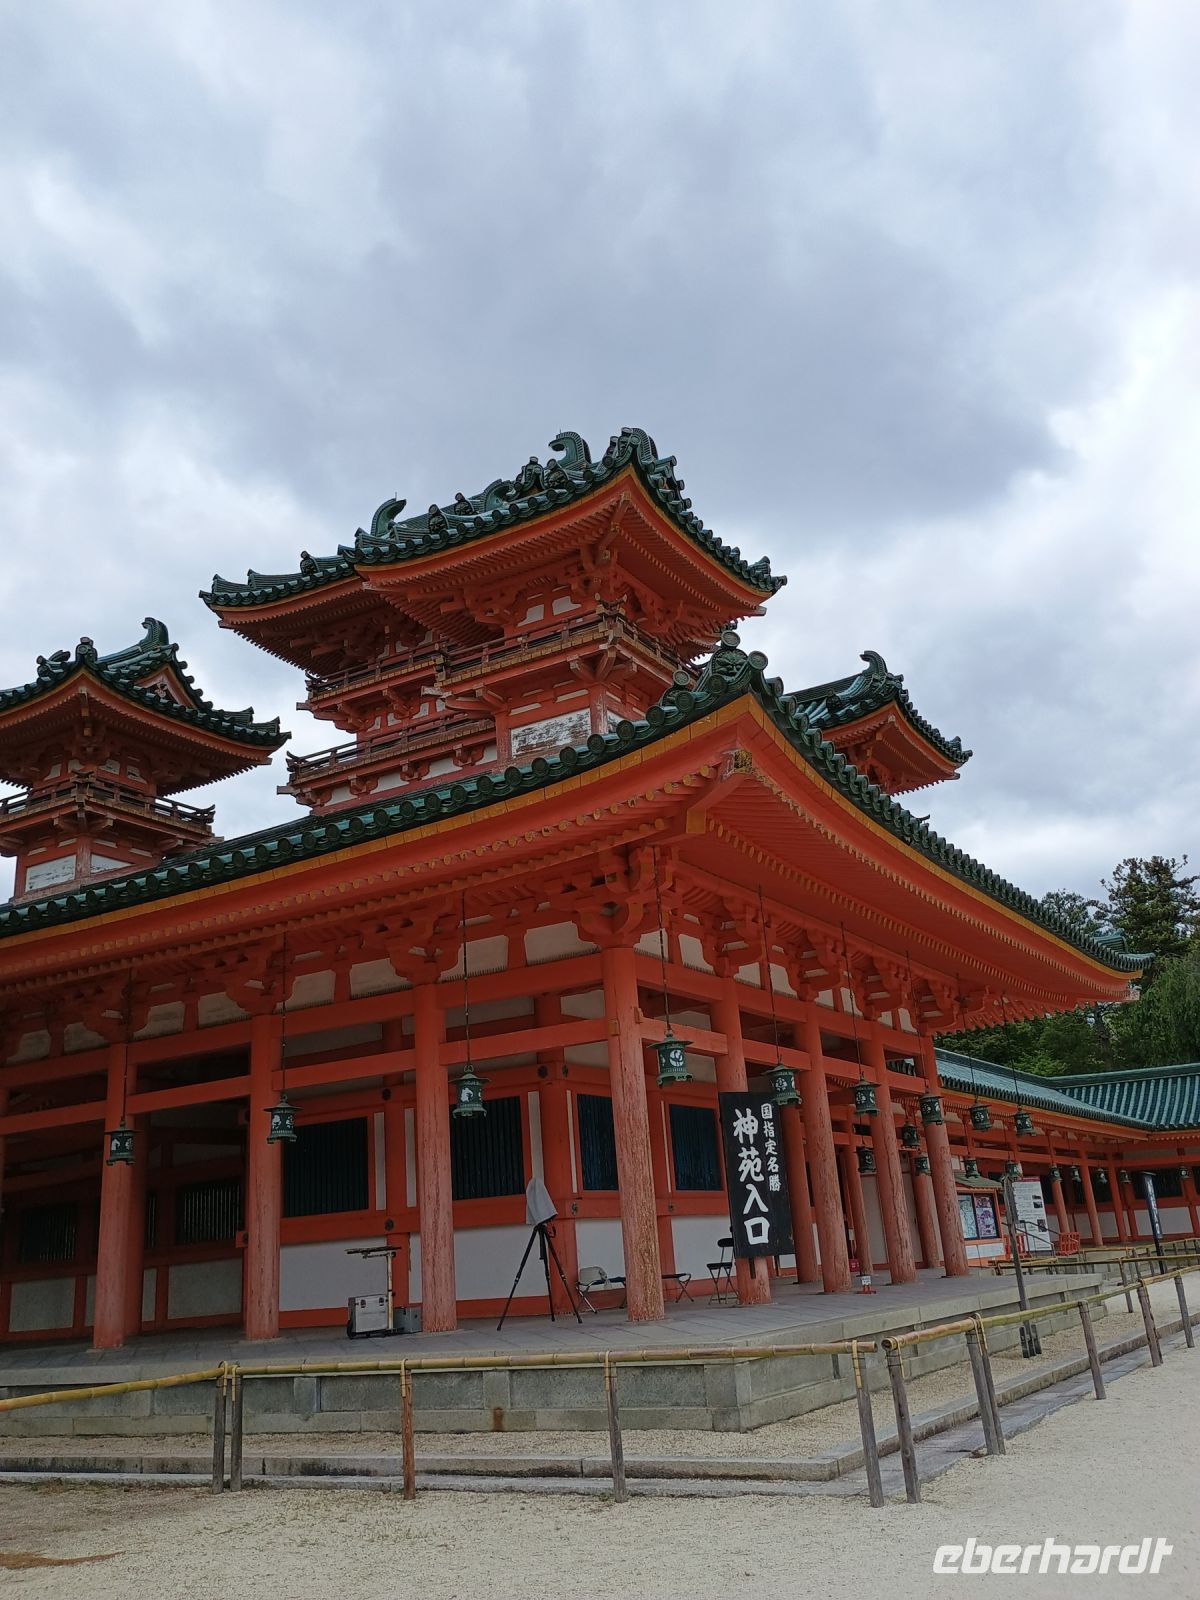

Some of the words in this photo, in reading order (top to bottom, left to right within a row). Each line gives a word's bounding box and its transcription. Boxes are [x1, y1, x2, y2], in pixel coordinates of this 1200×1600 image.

[733, 1108, 770, 1245] 神苑入口
[761, 1103, 782, 1192] 国指定名勝
